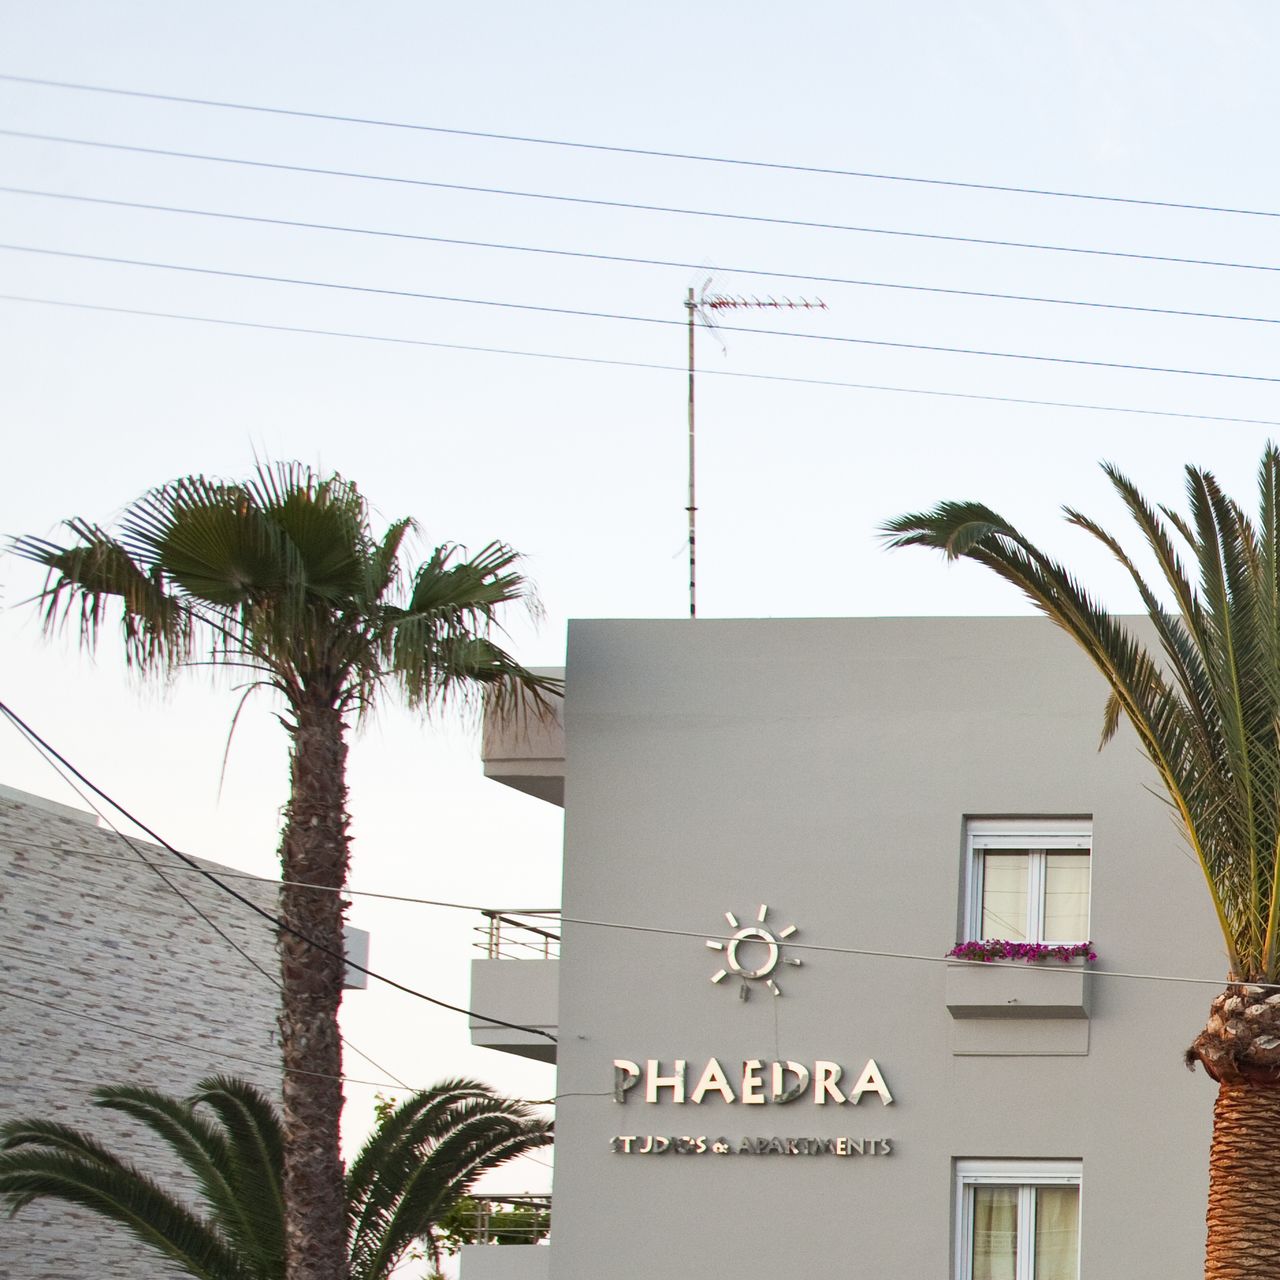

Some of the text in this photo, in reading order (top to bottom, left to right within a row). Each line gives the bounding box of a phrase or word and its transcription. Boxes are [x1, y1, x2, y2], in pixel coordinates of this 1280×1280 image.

[612, 1056, 894, 1105] PHAEDRA
[711, 1136, 729, 1154] &
[737, 1136, 892, 1155] APARTMENTS
